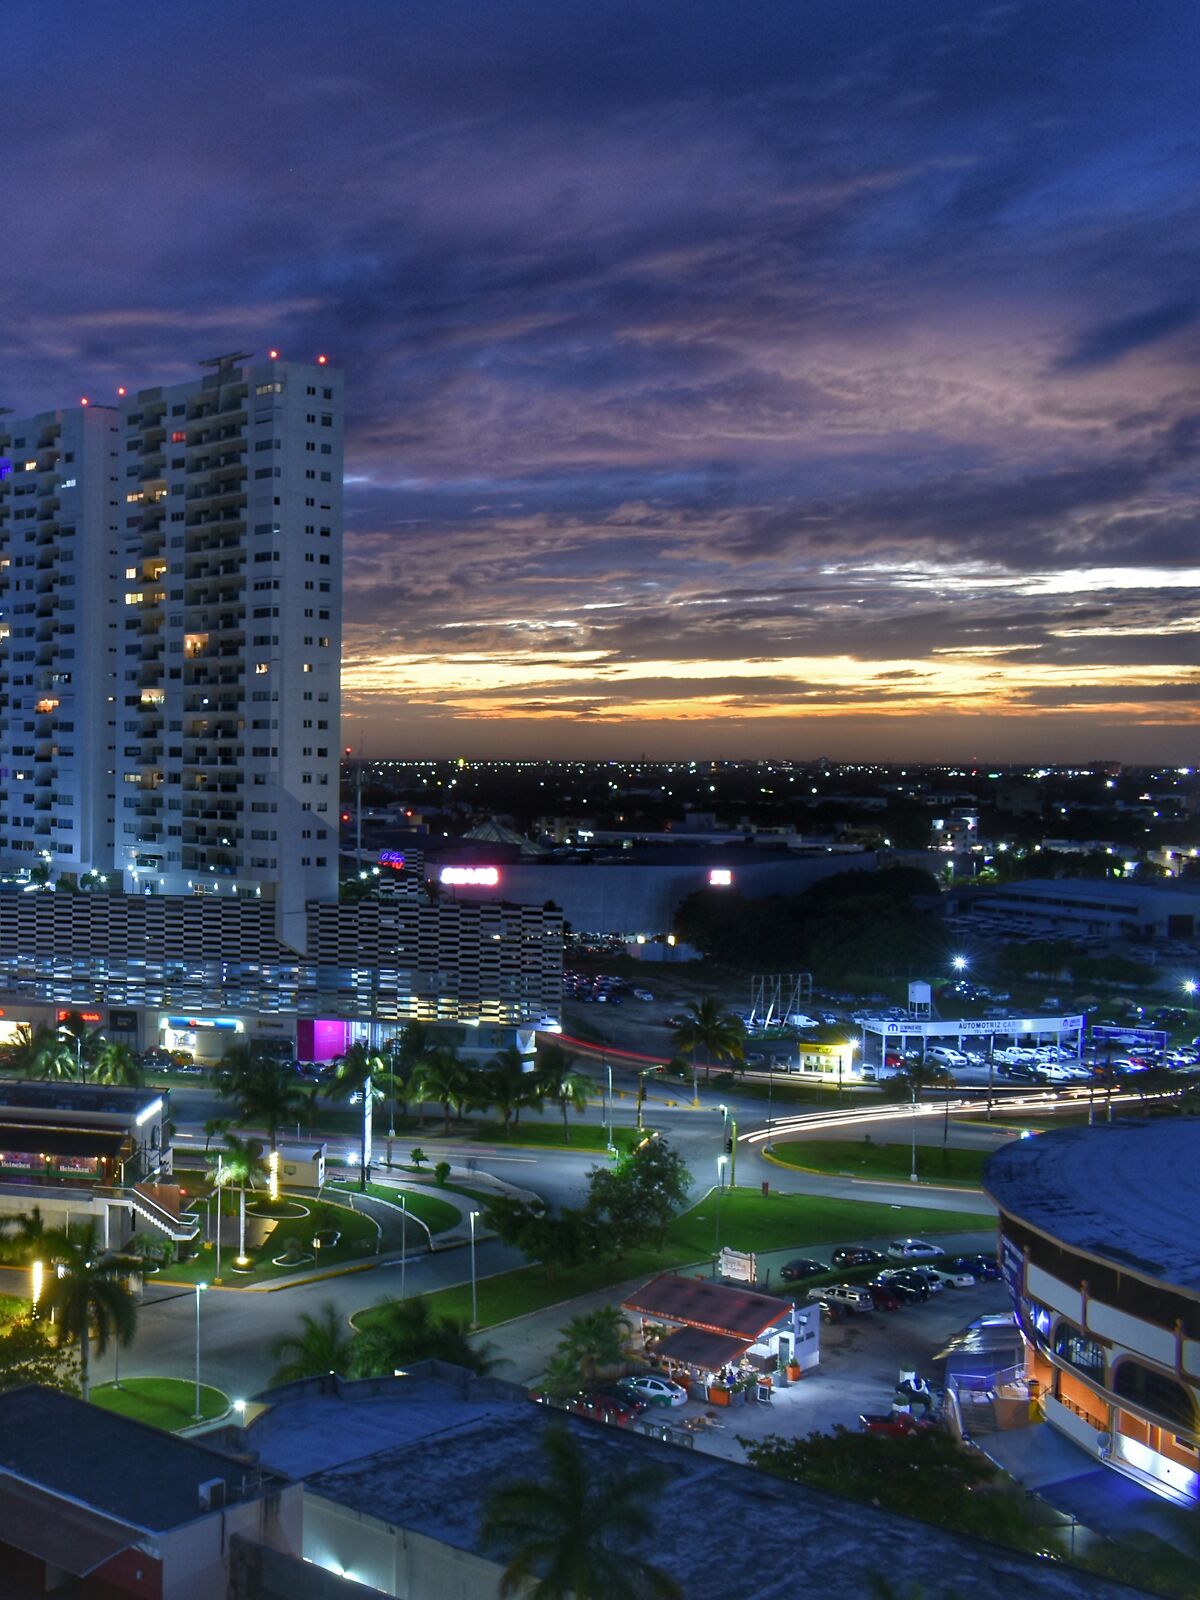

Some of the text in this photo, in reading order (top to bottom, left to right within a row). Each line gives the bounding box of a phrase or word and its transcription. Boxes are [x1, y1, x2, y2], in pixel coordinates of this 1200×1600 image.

[958, 1021, 1000, 1029] AUTOMOTRIZ
[1, 1161, 31, 1169] Heineken
[60, 1165, 90, 1173] Heineken
